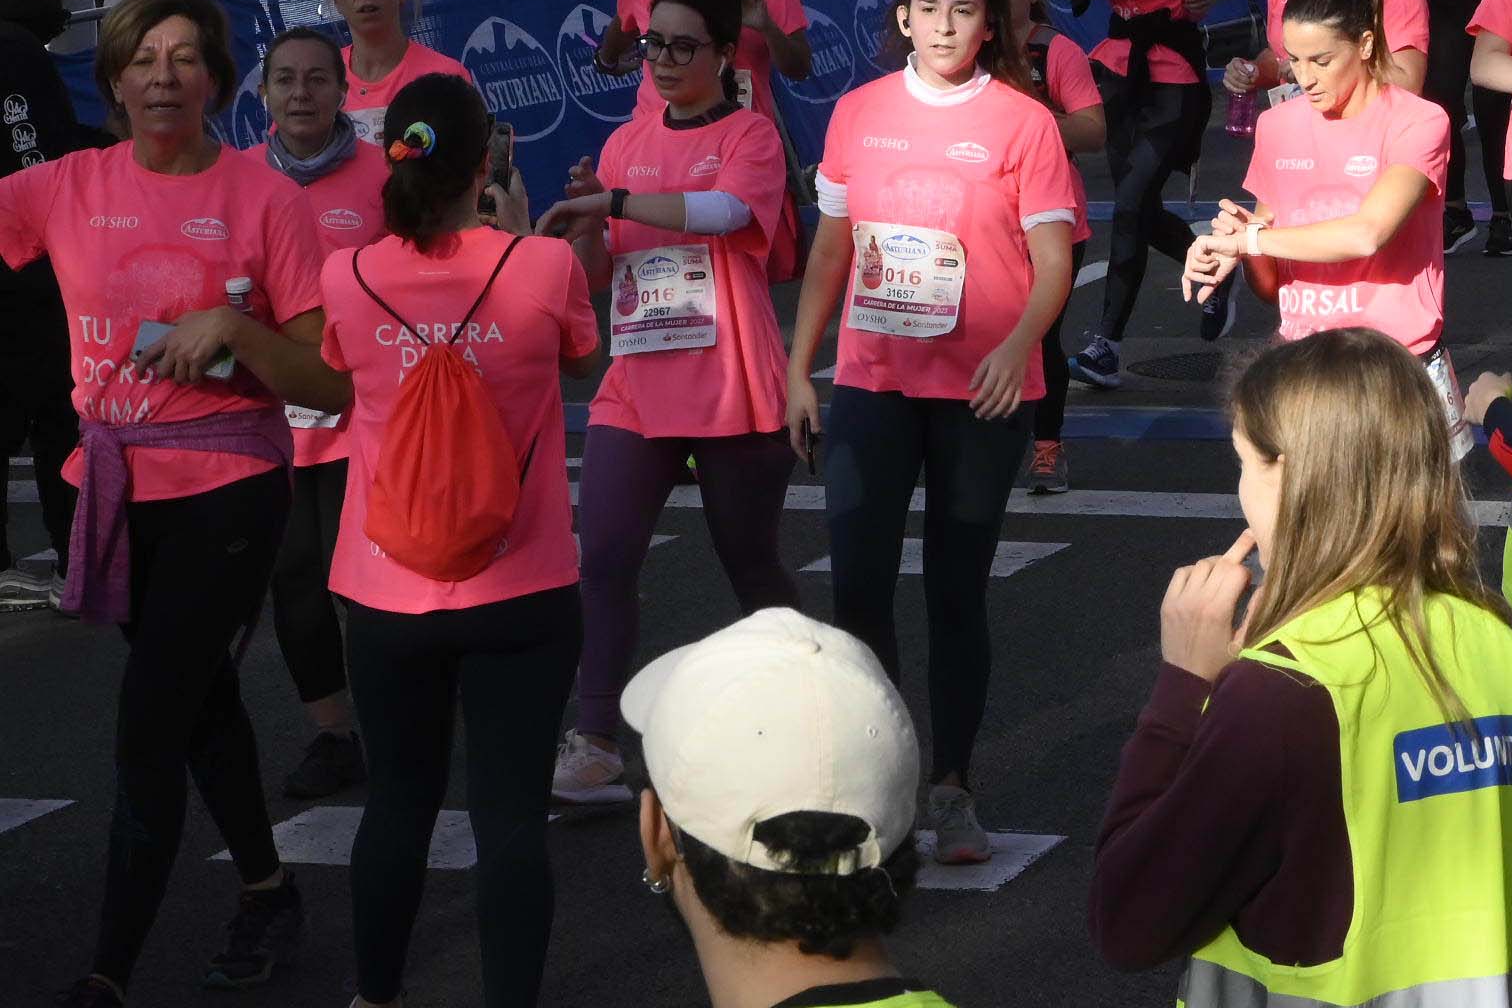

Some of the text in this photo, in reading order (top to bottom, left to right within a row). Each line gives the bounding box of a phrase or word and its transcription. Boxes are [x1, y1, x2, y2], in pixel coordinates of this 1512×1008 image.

[863, 136, 910, 152] OYSHO
[1275, 158, 1315, 171] OYSHO
[90, 215, 138, 229] OYSHO
[935, 243, 957, 253] SUMA
[885, 267, 922, 285] 016
[641, 287, 675, 305] 016
[886, 288, 916, 300] 31657
[643, 307, 671, 318] 22967
[863, 299, 887, 308] CARRERA
[906, 304, 931, 313] MUJER
[665, 318, 688, 327] MUJER
[857, 313, 887, 325] OYSHO
[912, 319, 948, 329] Santander
[79, 315, 112, 345] TU
[376, 321, 504, 346] CARRERA
[618, 337, 647, 348] OYSHO
